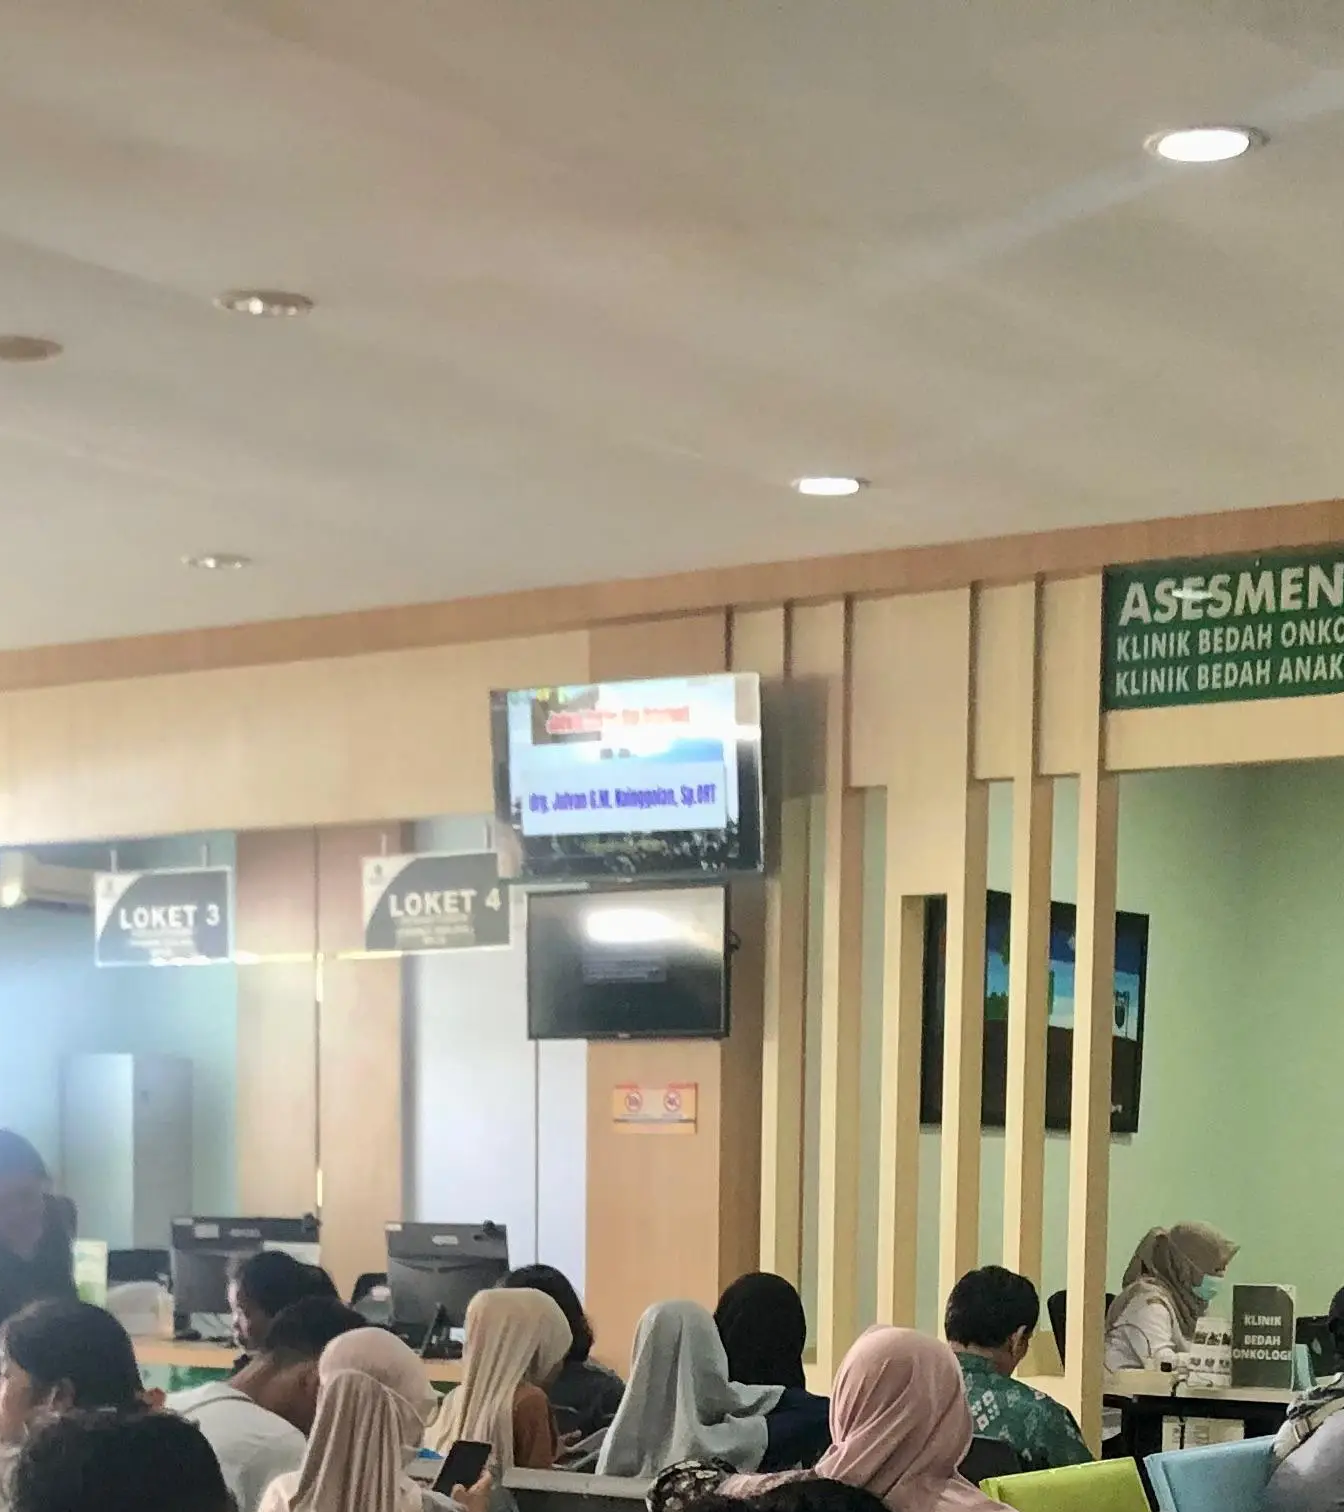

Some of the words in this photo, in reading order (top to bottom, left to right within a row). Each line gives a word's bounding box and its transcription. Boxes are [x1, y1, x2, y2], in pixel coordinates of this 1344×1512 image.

[1119, 562, 1344, 626] ASESMEN
[1116, 630, 1190, 662] KLINIK
[1197, 624, 1273, 656] BEDAH
[1115, 664, 1190, 697] KLINIK
[1197, 658, 1272, 690] BEDAH
[1278, 653, 1344, 684] ANAK
[119, 904, 197, 931] LOKET
[206, 903, 221, 926] 3
[389, 888, 477, 918] LOKET
[484, 887, 502, 911] 4
[1243, 1314, 1282, 1327] KLINIK
[1244, 1334, 1281, 1346] BEDAH
